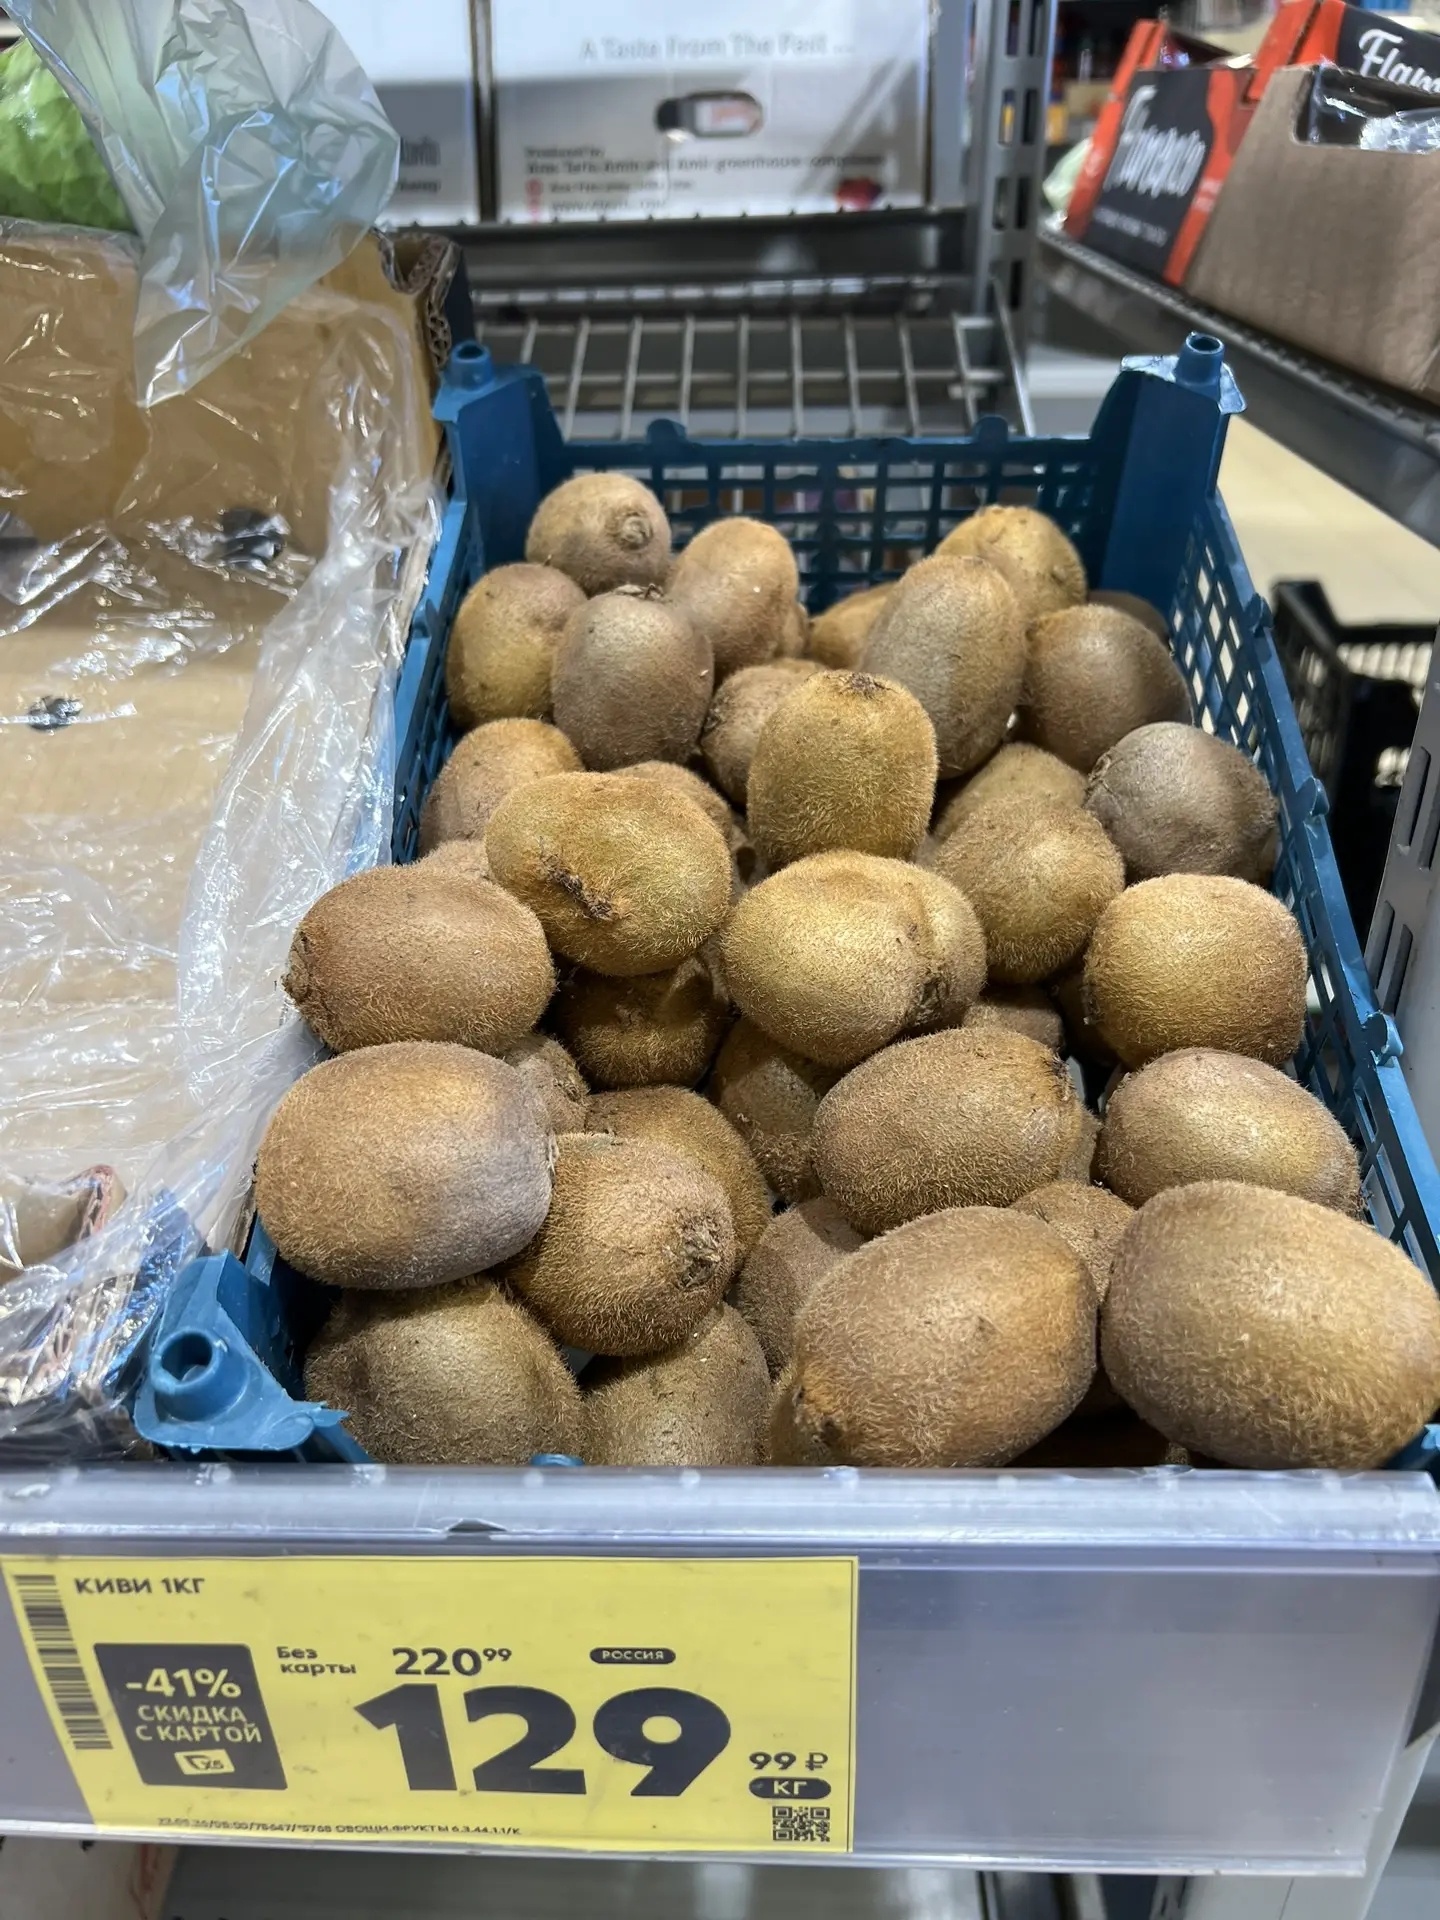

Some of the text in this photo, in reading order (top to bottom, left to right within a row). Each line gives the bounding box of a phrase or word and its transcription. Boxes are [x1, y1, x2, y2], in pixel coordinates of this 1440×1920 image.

[579, 38, 597, 59] A
[602, 37, 661, 60] Taste
[665, 35, 727, 58] From
[729, 31, 775, 57] The
[778, 30, 828, 55] Past
[74, 1578, 205, 1594] КИВИ 1КГ
[276, 1646, 318, 1660] Без
[602, 1650, 664, 1660] РОССИЯ
[280, 1663, 357, 1677] карты
[126, 1668, 241, 1698] -41%
[137, 1705, 247, 1724] СКИДКА
[135, 1722, 262, 1743] С КАРТОЙ
[353, 1683, 731, 1796] 129
[749, 1751, 796, 1770] 99
[773, 1780, 807, 1795] КГ
